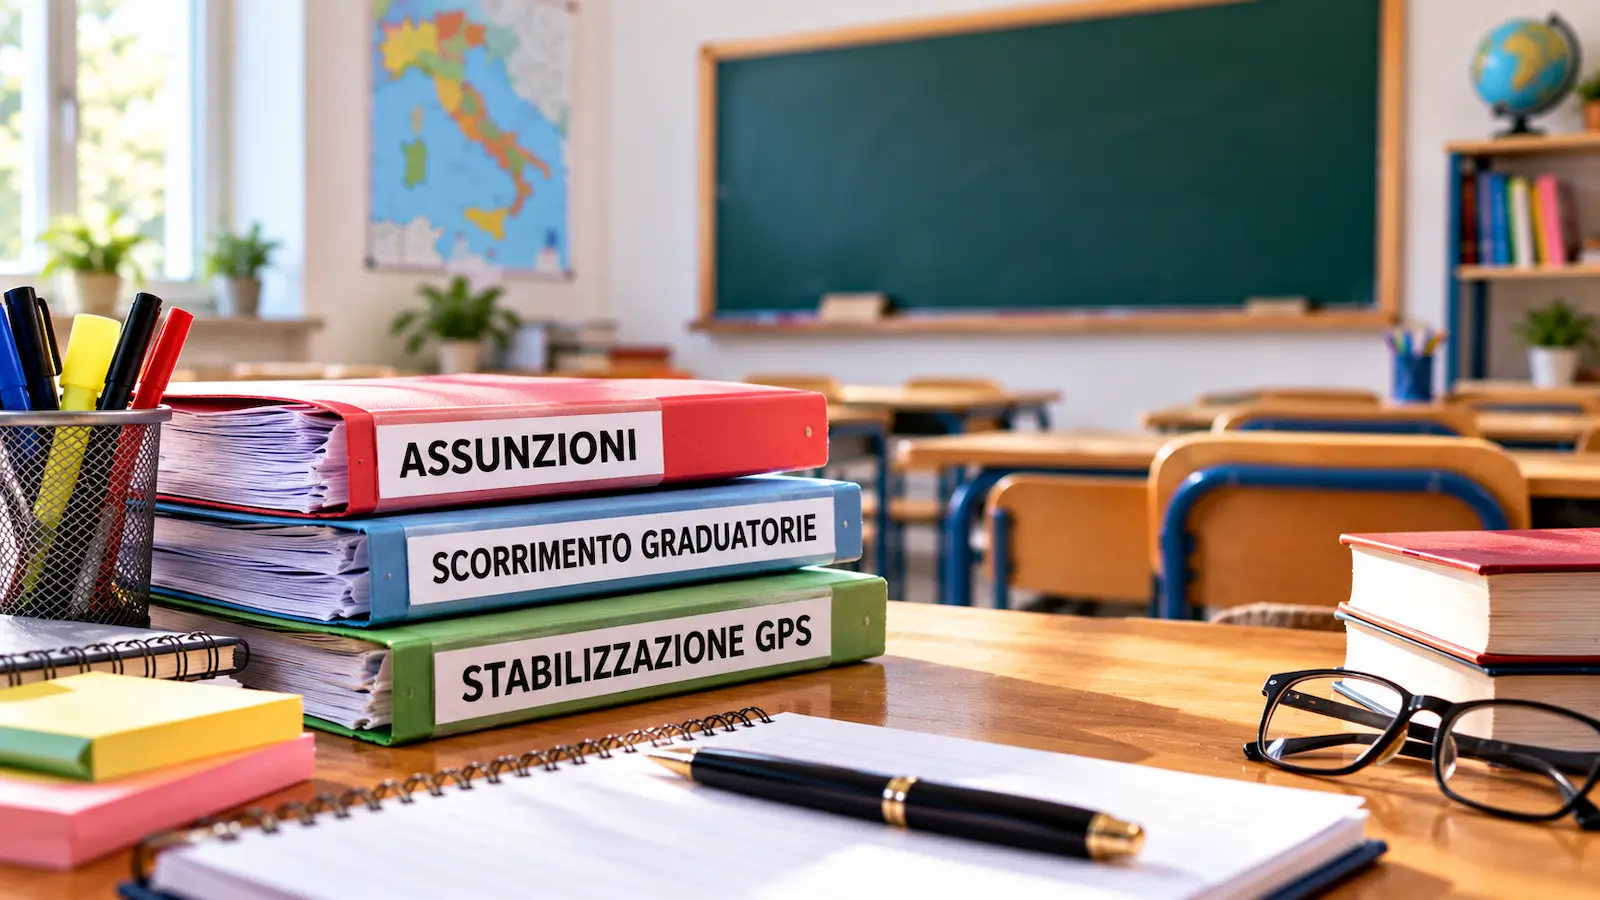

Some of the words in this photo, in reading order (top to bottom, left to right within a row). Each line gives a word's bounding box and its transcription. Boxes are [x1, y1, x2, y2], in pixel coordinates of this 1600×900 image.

[399, 428, 637, 479] ASSUNZIONI
[432, 533, 632, 585] SCORRIMENTO
[641, 514, 817, 560] GRADUATORIE
[461, 625, 745, 702] STABILIZZAZIONE
[756, 615, 812, 653] GPS
